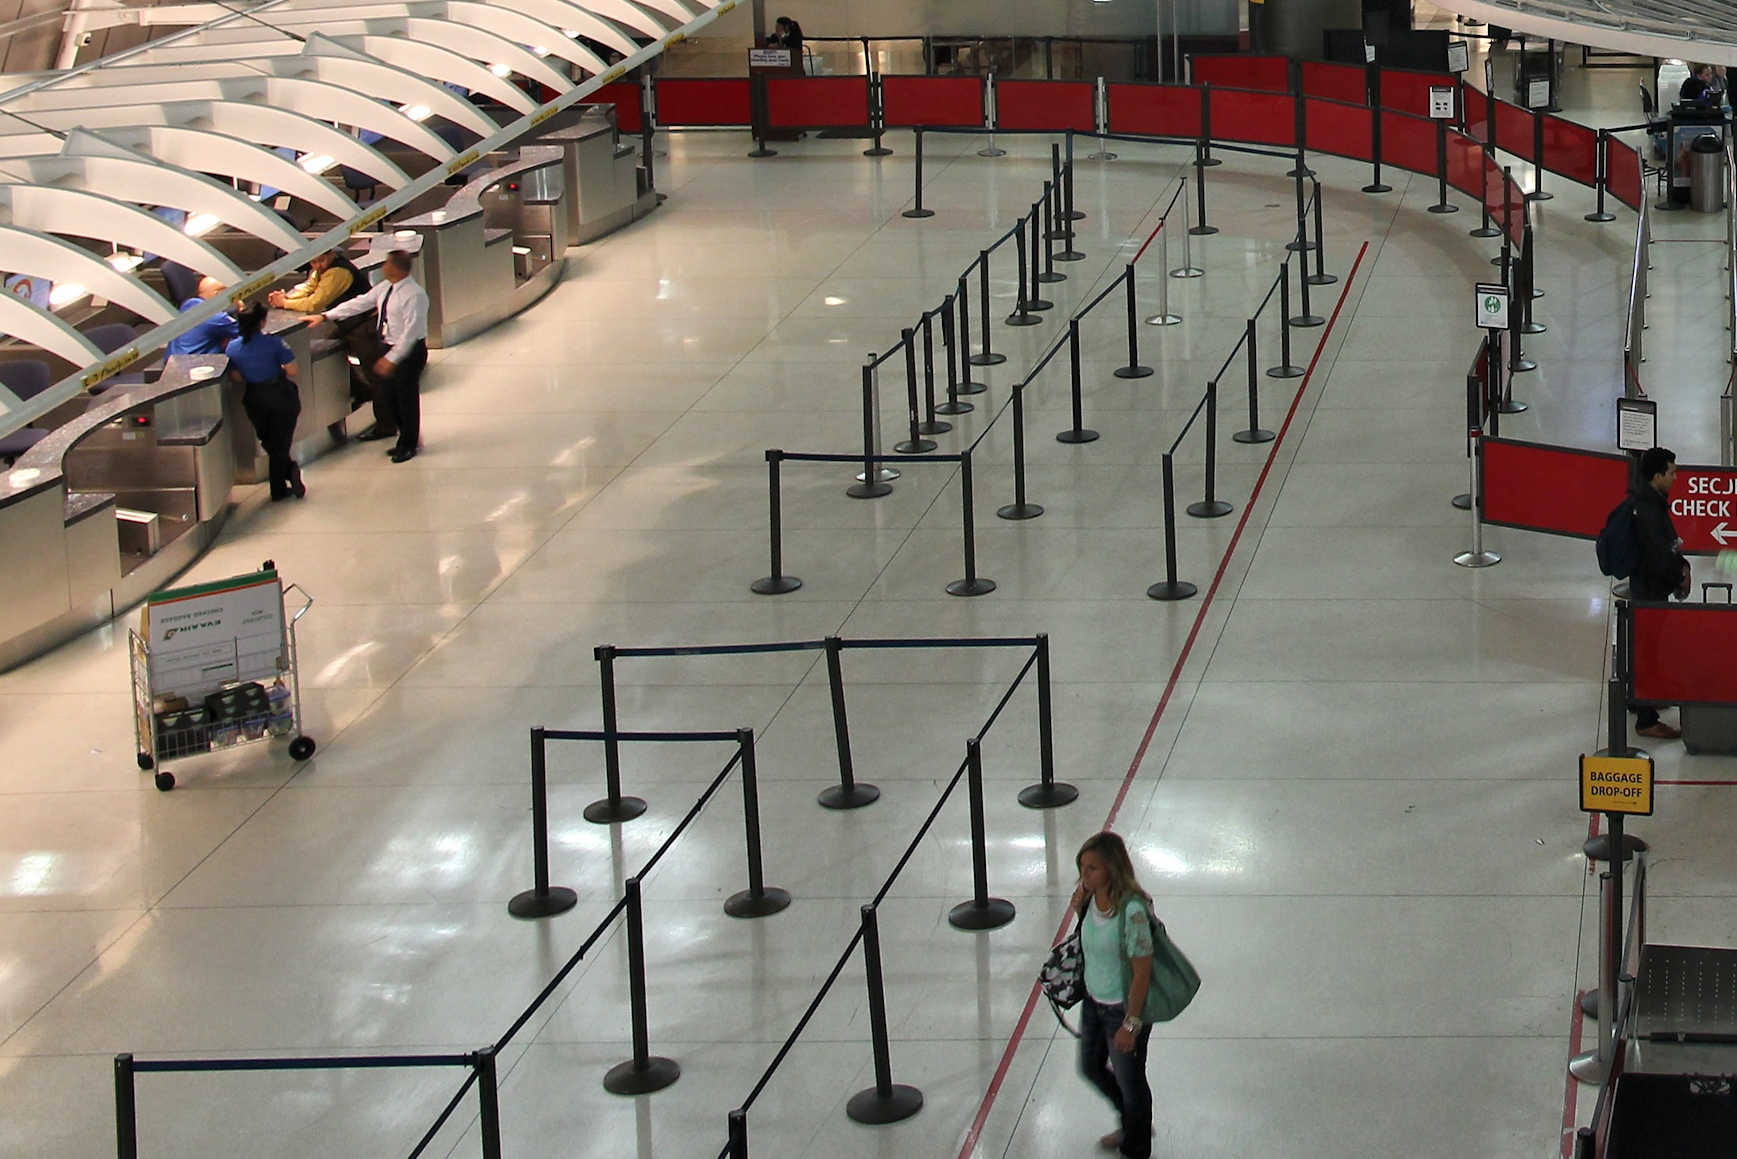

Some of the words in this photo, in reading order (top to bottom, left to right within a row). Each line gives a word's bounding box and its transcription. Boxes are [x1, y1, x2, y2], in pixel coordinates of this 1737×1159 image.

[1671, 499, 1731, 517] CHECK
[180, 623, 198, 632] AIR
[200, 619, 222, 629] EVA
[1590, 771, 1642, 784] BAGGAGE
[1591, 786, 1642, 798] DROP-OFF
